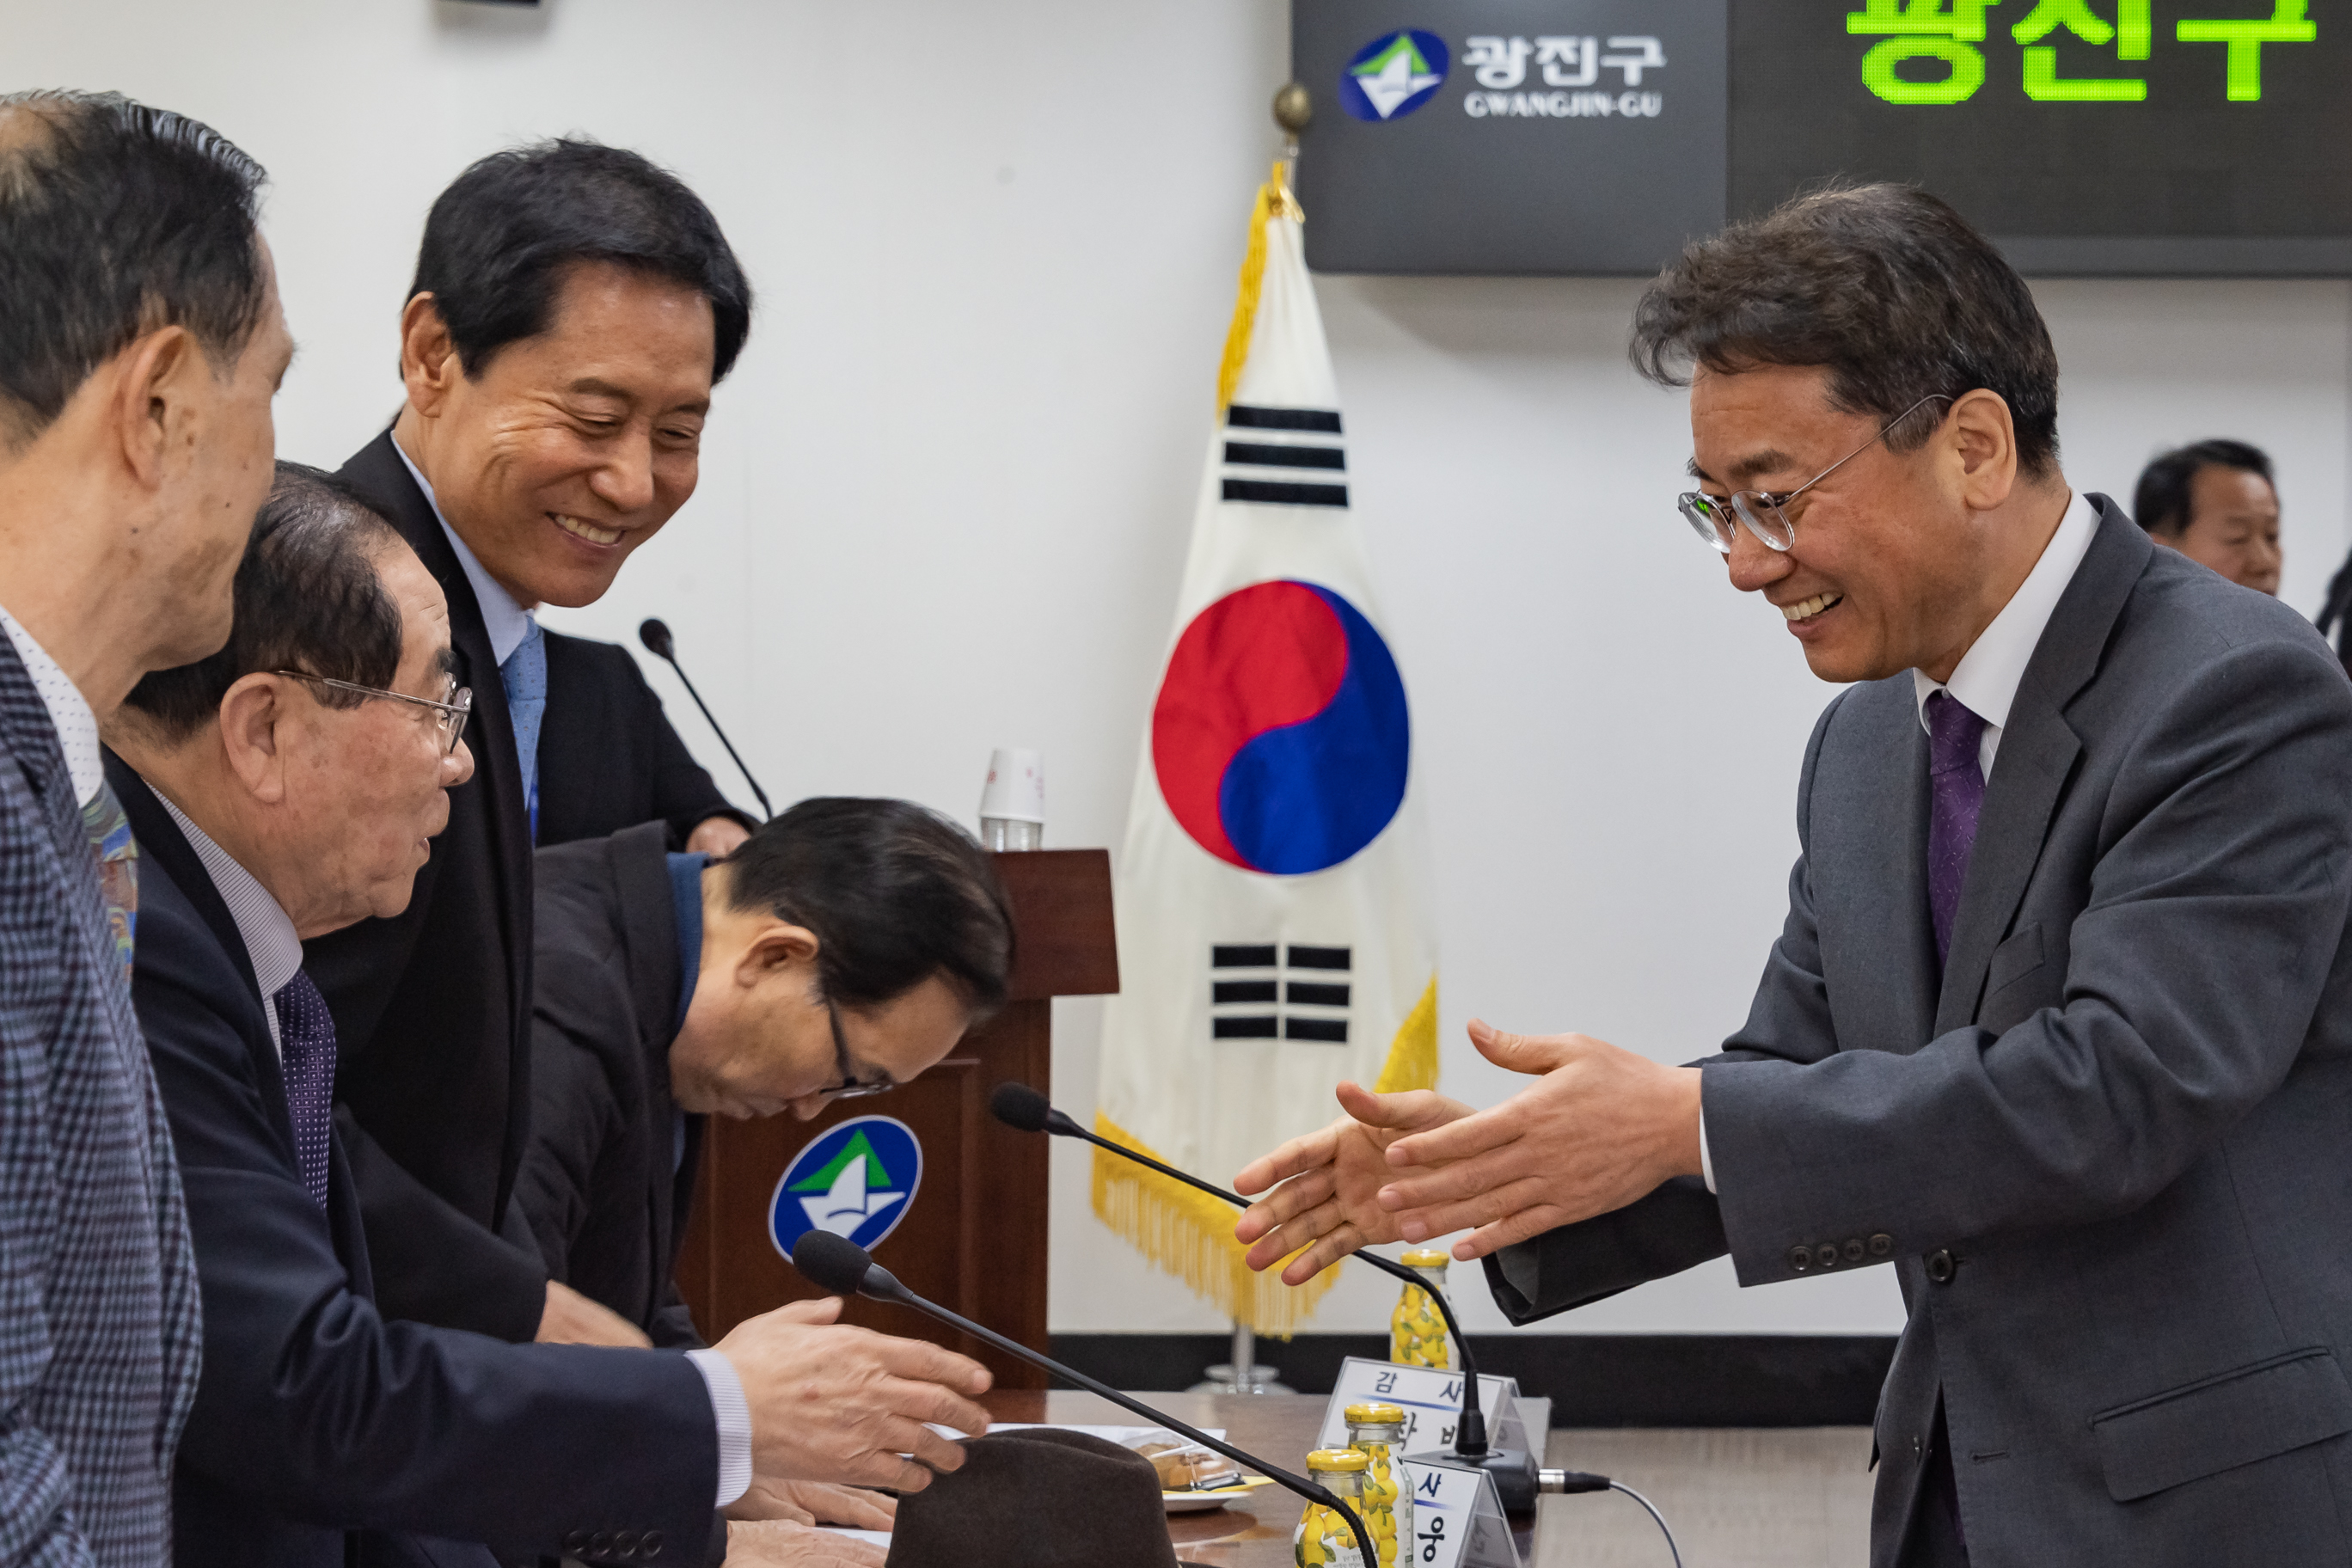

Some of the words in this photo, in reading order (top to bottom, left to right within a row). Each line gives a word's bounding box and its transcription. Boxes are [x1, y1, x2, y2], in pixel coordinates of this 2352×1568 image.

[1461, 35, 1668, 89] 광진구
[1463, 90, 1663, 118] GWANGJIN-GU
[1418, 1472, 1442, 1498] 사
[1417, 1516, 1446, 1563] 웅
